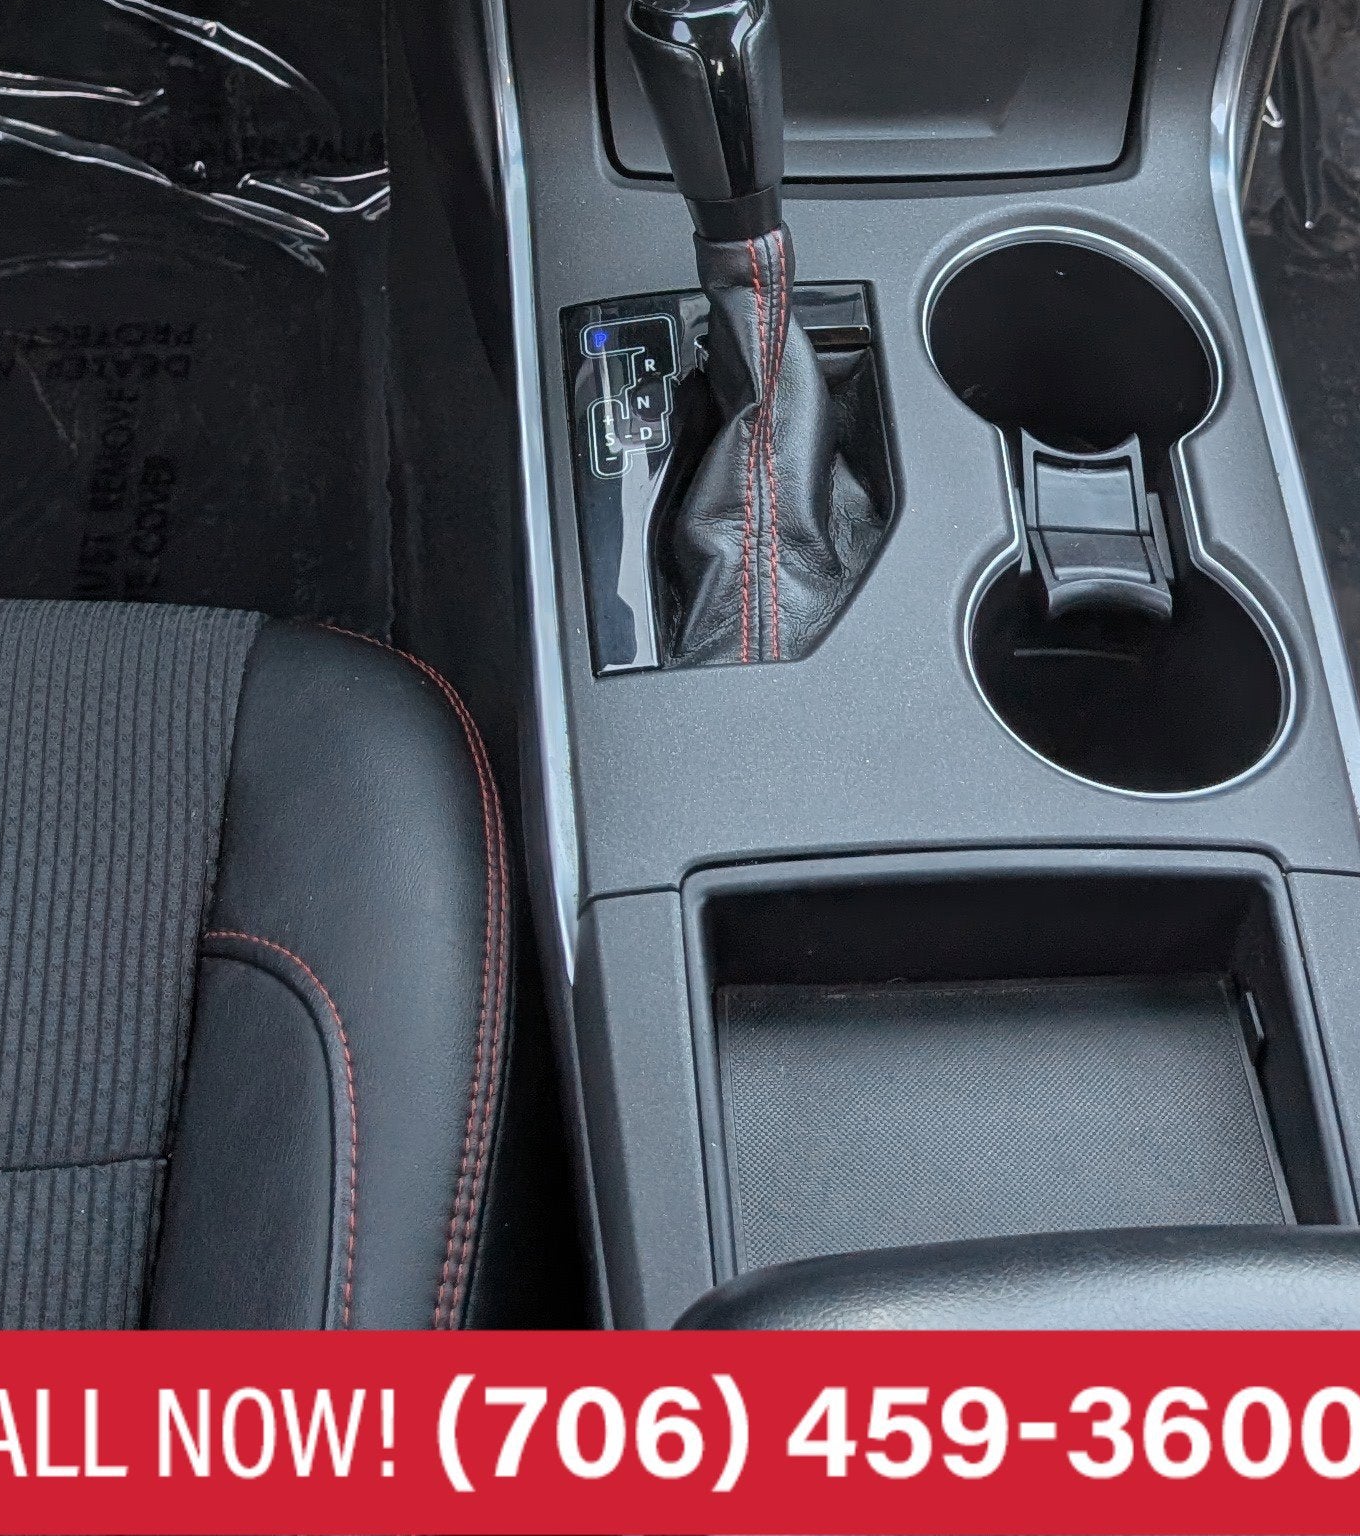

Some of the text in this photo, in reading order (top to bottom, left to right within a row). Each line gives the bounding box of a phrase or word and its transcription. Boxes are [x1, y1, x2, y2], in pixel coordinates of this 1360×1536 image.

[593, 331, 608, 348] P
[644, 358, 657, 372] R
[636, 395, 651, 410] N
[604, 427, 653, 447] S D
